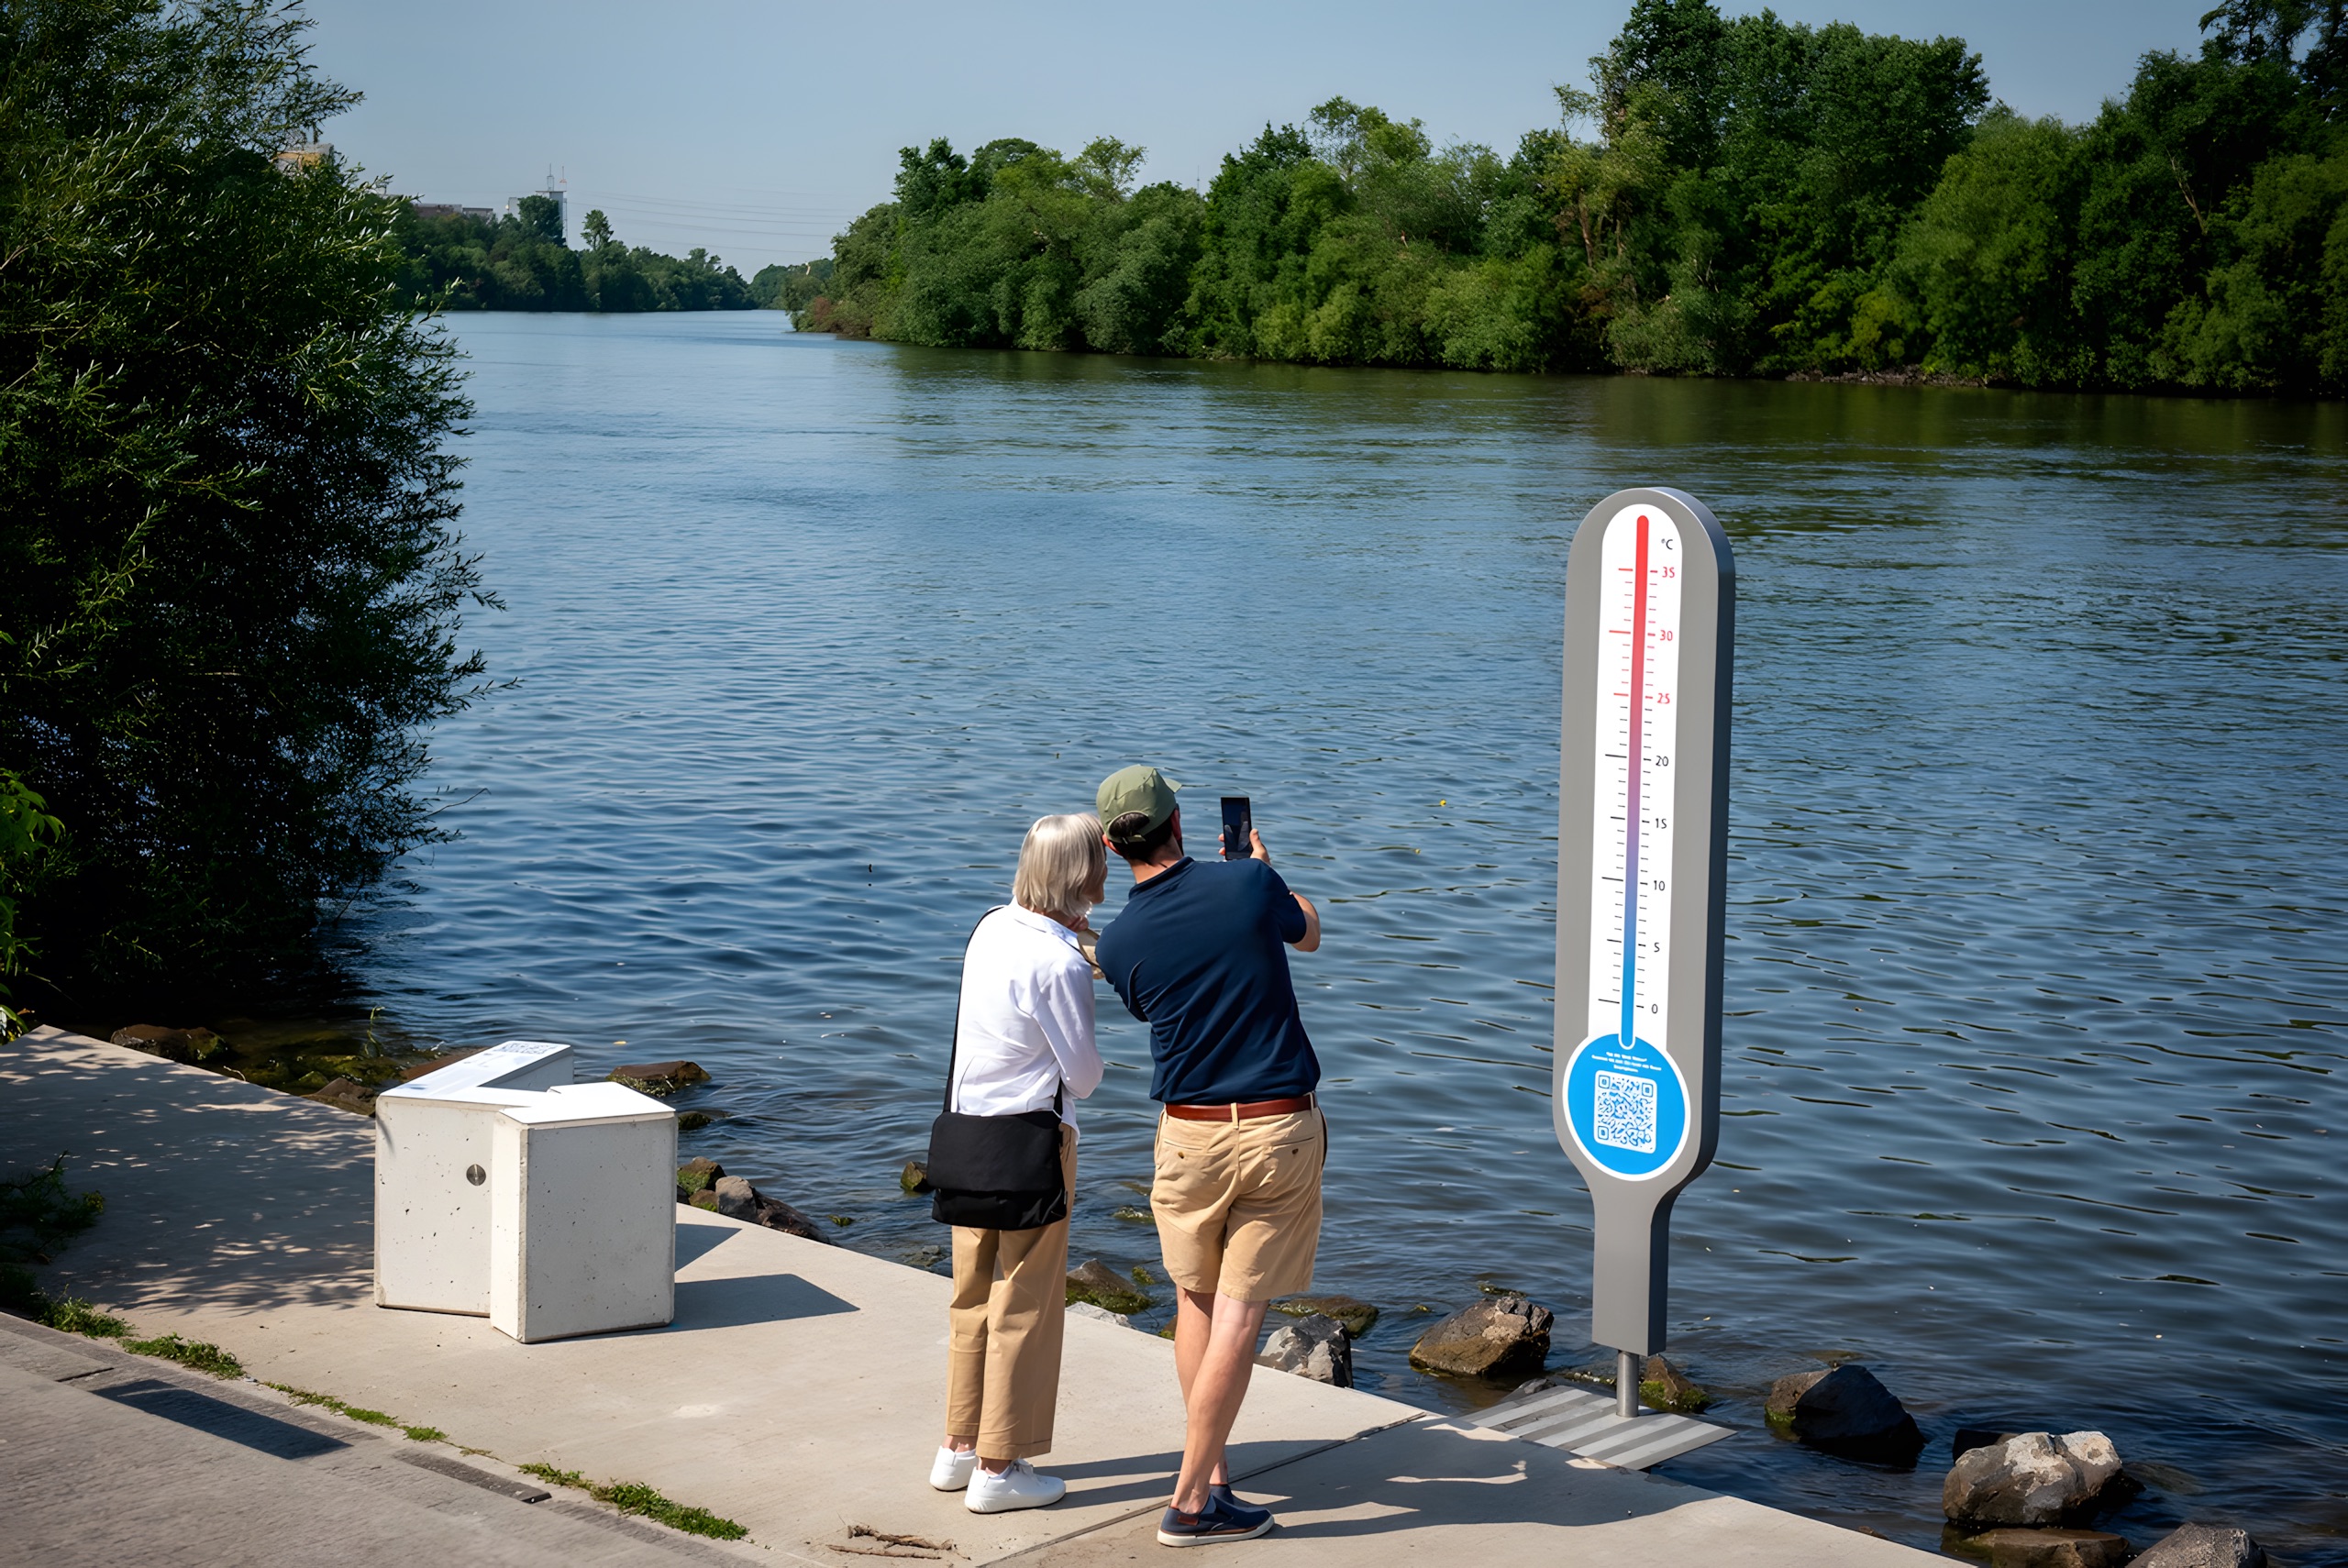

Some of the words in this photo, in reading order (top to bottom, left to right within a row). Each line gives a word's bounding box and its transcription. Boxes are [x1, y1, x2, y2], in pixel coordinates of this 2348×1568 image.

[1662, 566, 1676, 579] 35
[1659, 629, 1674, 642] 30
[1656, 692, 1670, 705] 25
[1655, 755, 1669, 767] 20
[1655, 817, 1667, 830] 15
[1653, 879, 1666, 891] 10
[1654, 942, 1660, 953] 5
[1651, 1003, 1658, 1014] 0
